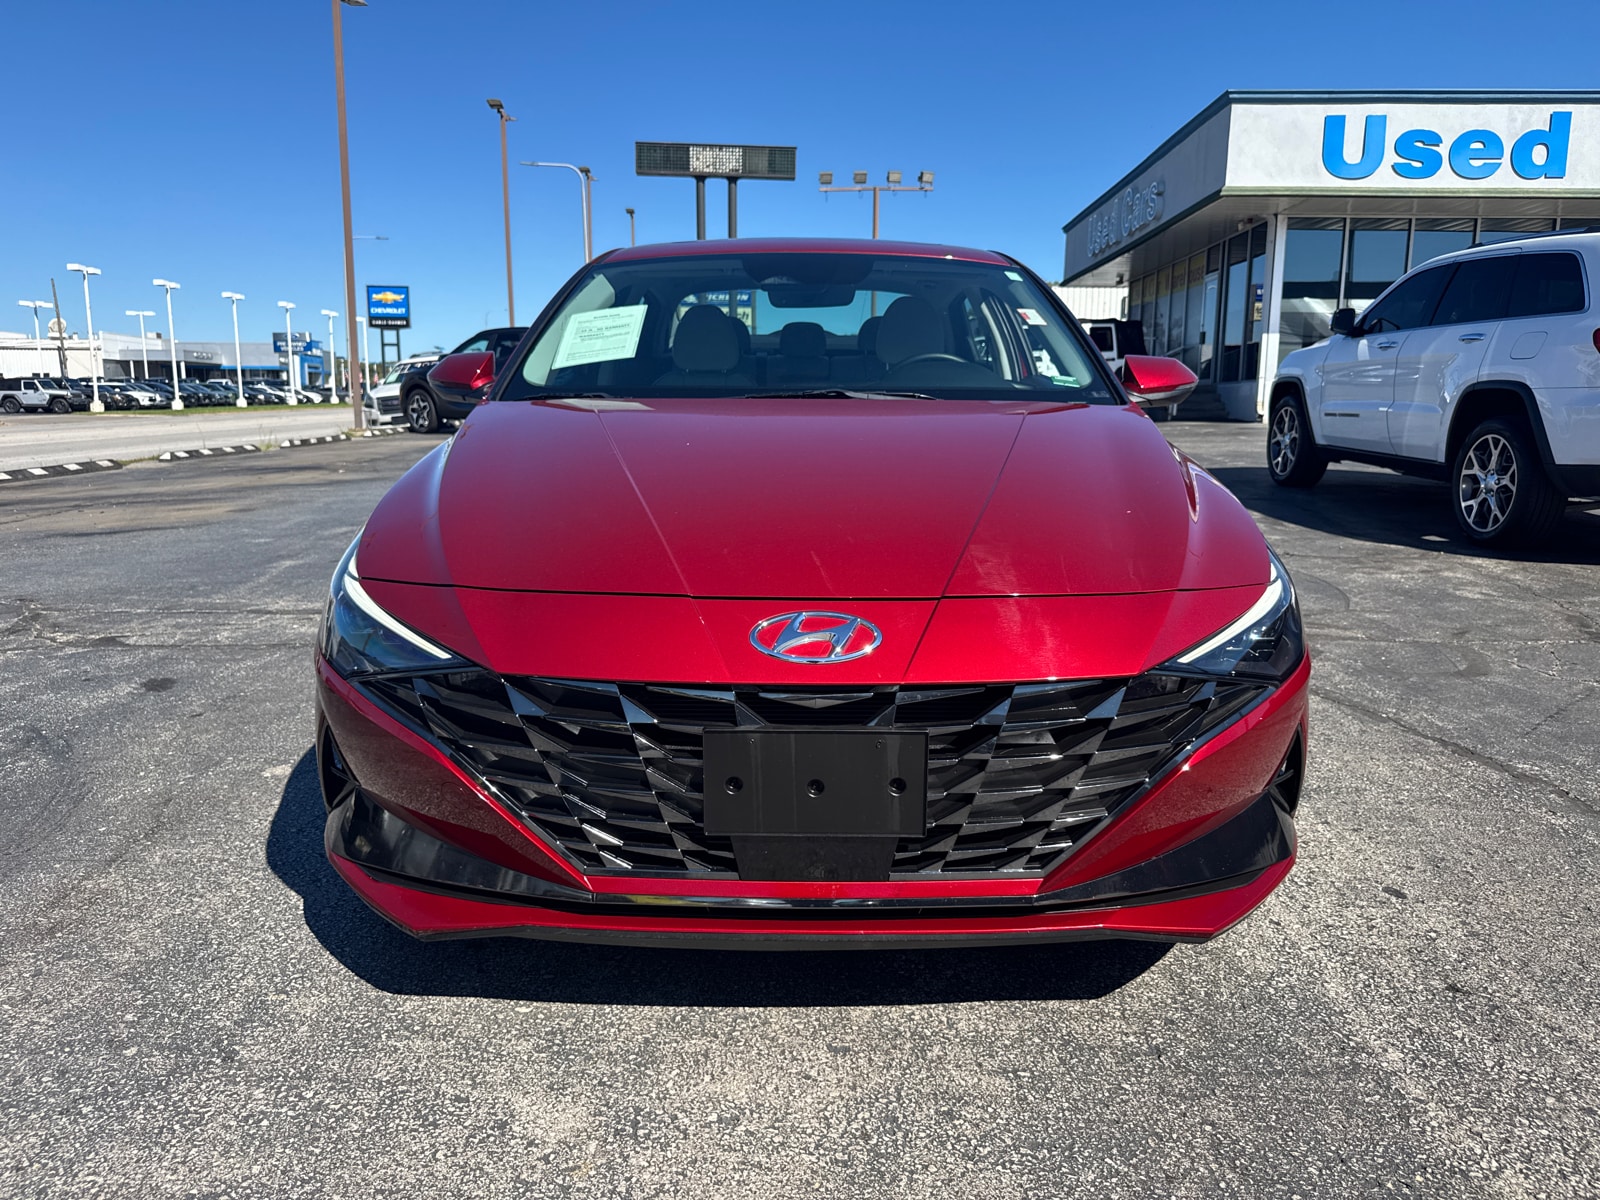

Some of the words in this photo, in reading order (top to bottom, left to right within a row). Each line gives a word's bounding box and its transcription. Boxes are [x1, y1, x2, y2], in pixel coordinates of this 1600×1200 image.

[1322, 111, 1572, 180] Used
[1087, 199, 1119, 257] Used
[1121, 181, 1159, 237] Cars
[370, 307, 406, 315] CHEVROLET
